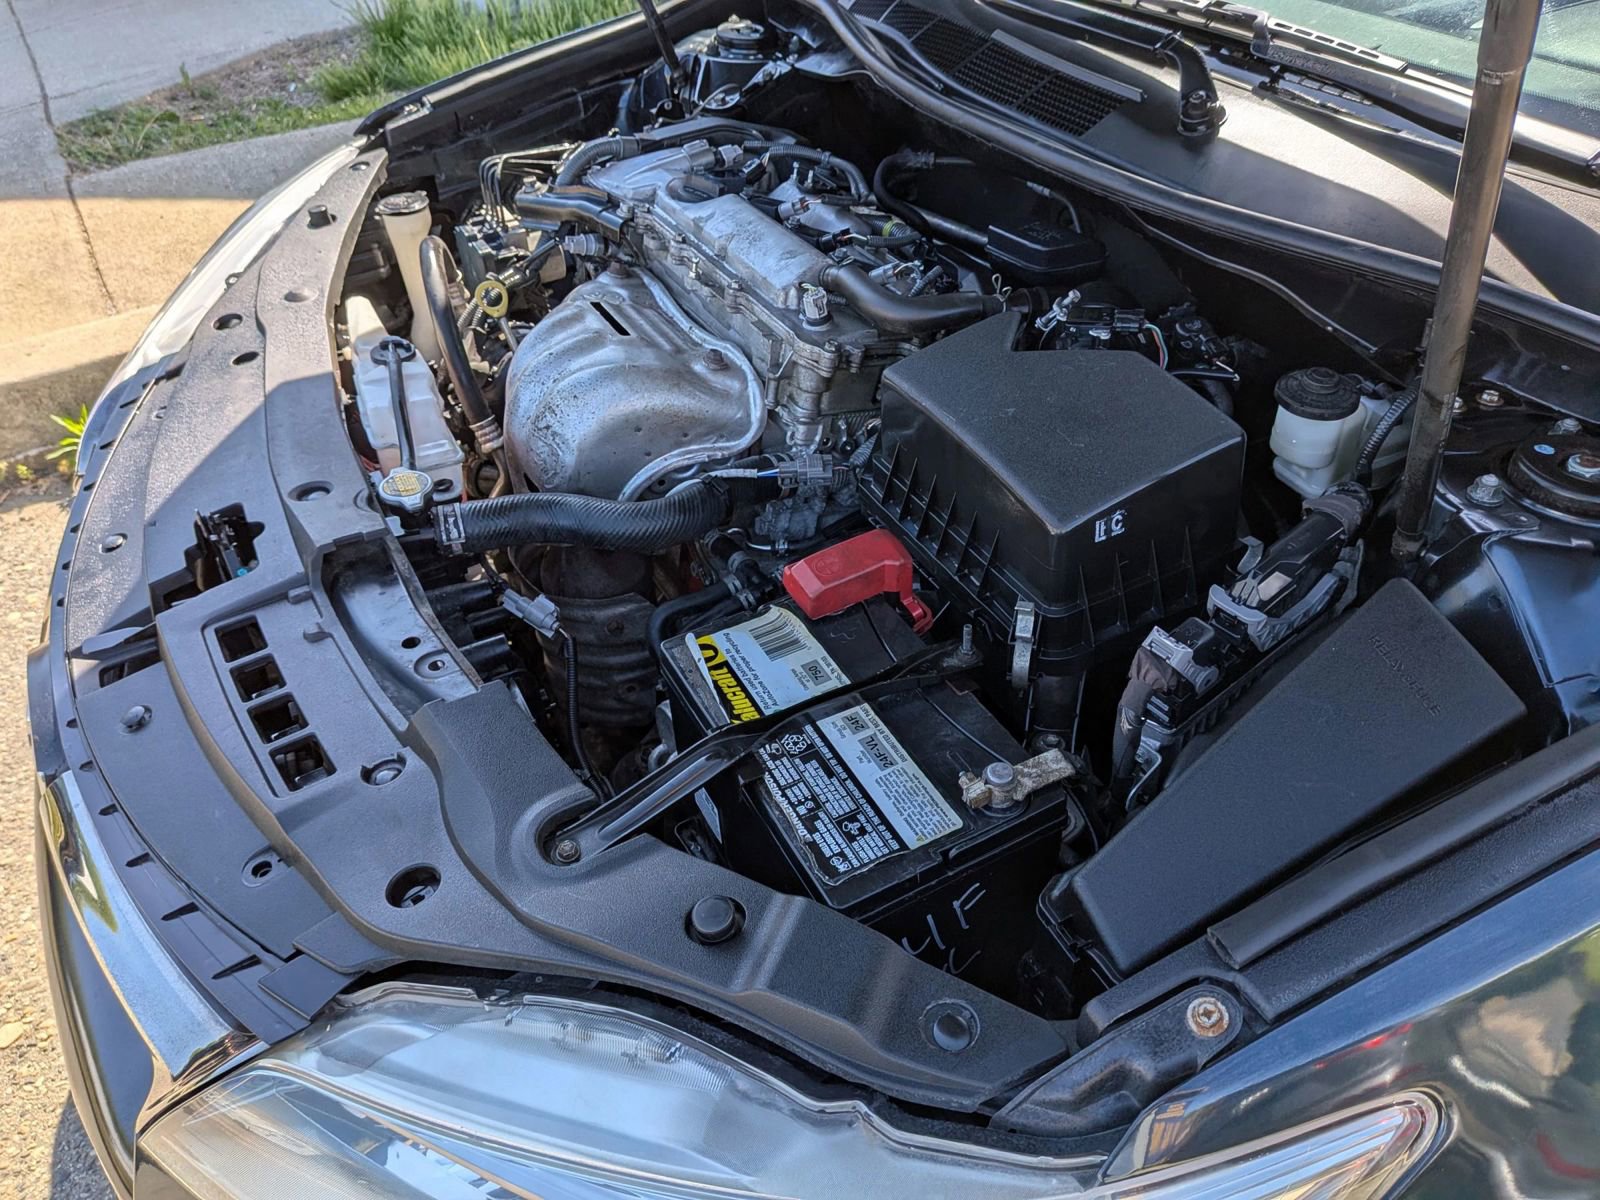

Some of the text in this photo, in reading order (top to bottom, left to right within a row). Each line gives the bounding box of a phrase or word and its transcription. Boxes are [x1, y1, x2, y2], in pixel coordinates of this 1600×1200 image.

[723, 647, 732, 655] to
[721, 631, 779, 708] AutoZone for proper recycling
[807, 664, 825, 680] 750
[742, 676, 758, 691] used
[709, 667, 761, 724] alucraft
[752, 690, 772, 710] Return
[845, 713, 865, 731] 24F
[862, 735, 894, 769] 24F-VL
